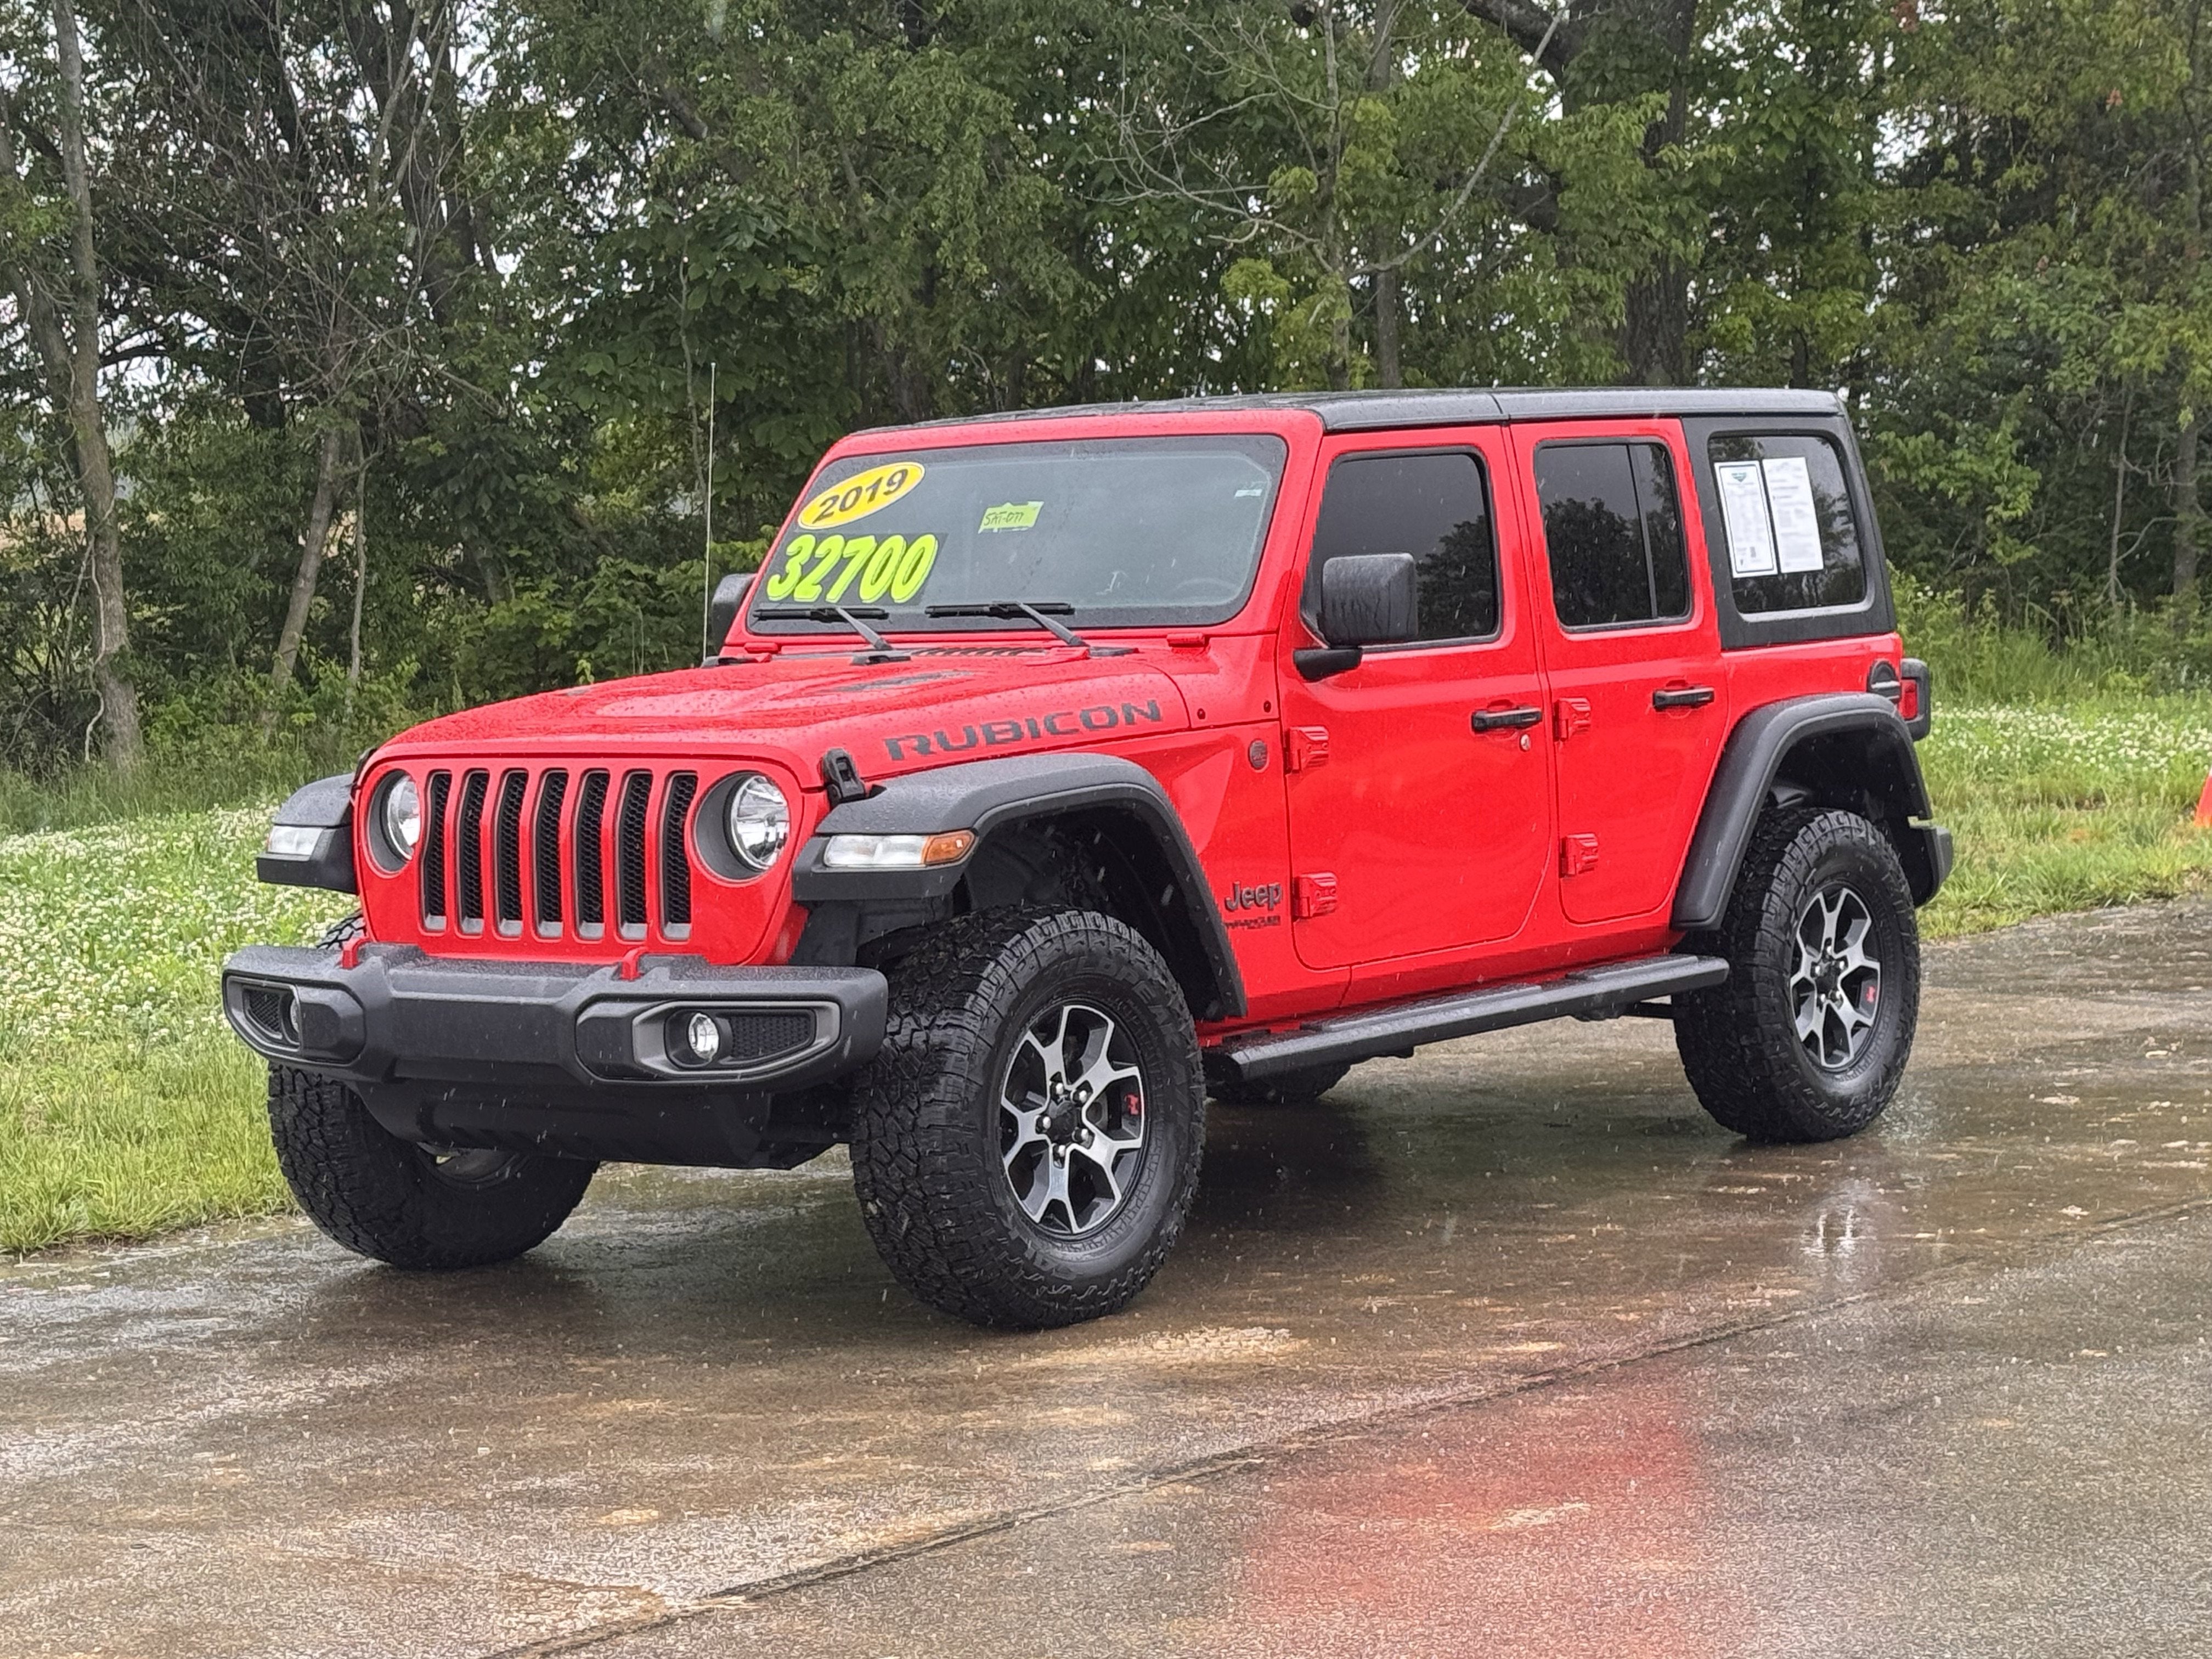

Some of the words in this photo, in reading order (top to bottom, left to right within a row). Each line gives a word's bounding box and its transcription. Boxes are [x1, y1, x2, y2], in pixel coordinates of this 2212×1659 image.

[812, 469, 909, 524] 2019
[768, 533, 939, 604] 32700
[883, 699, 1163, 761] RUBICON
[1224, 880, 1283, 911] Jeep
